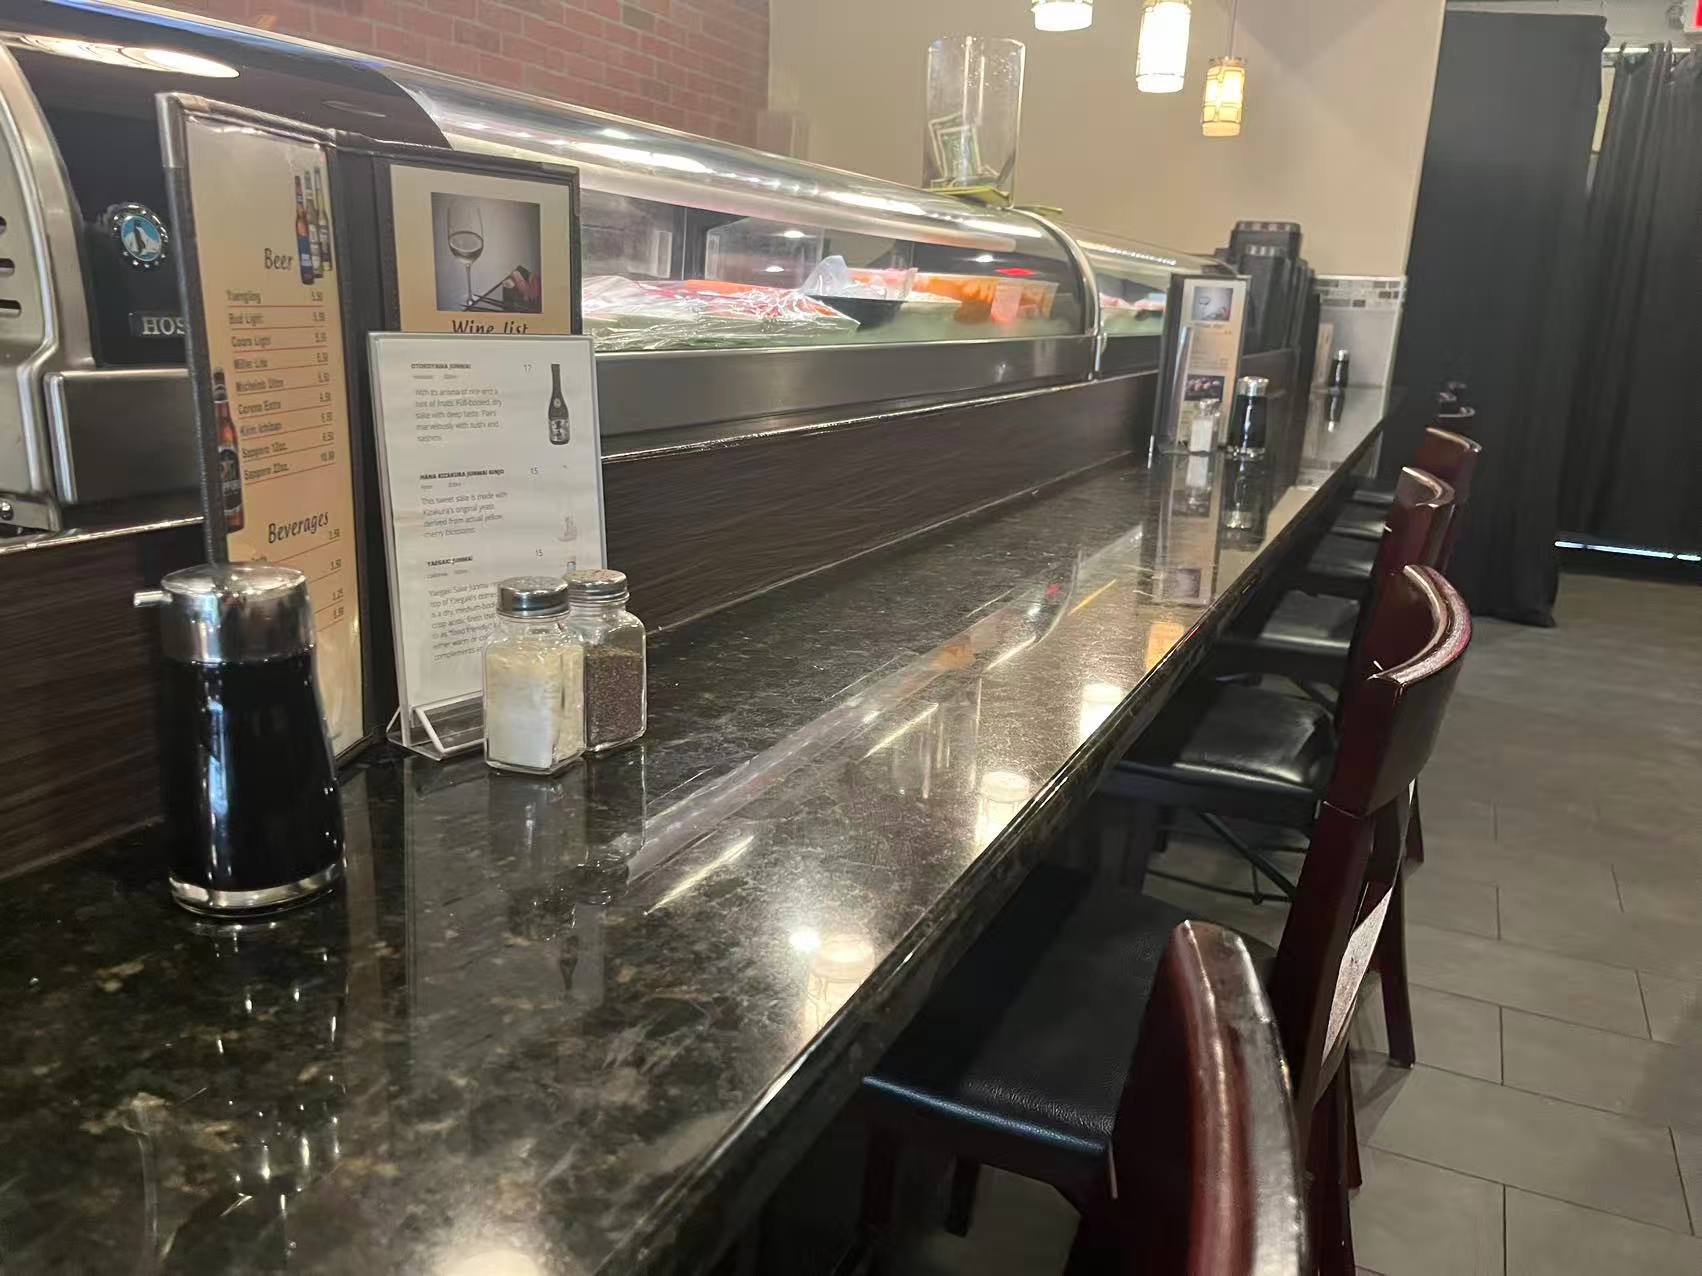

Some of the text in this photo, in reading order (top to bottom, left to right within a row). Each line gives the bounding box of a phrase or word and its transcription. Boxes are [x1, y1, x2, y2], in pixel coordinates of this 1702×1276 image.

[264, 247, 293, 270] Beer
[452, 320, 529, 334] Wine list
[524, 364, 533, 374] 17
[530, 467, 538, 476] 15
[268, 512, 329, 544] Beverages
[536, 549, 544, 557] 15
